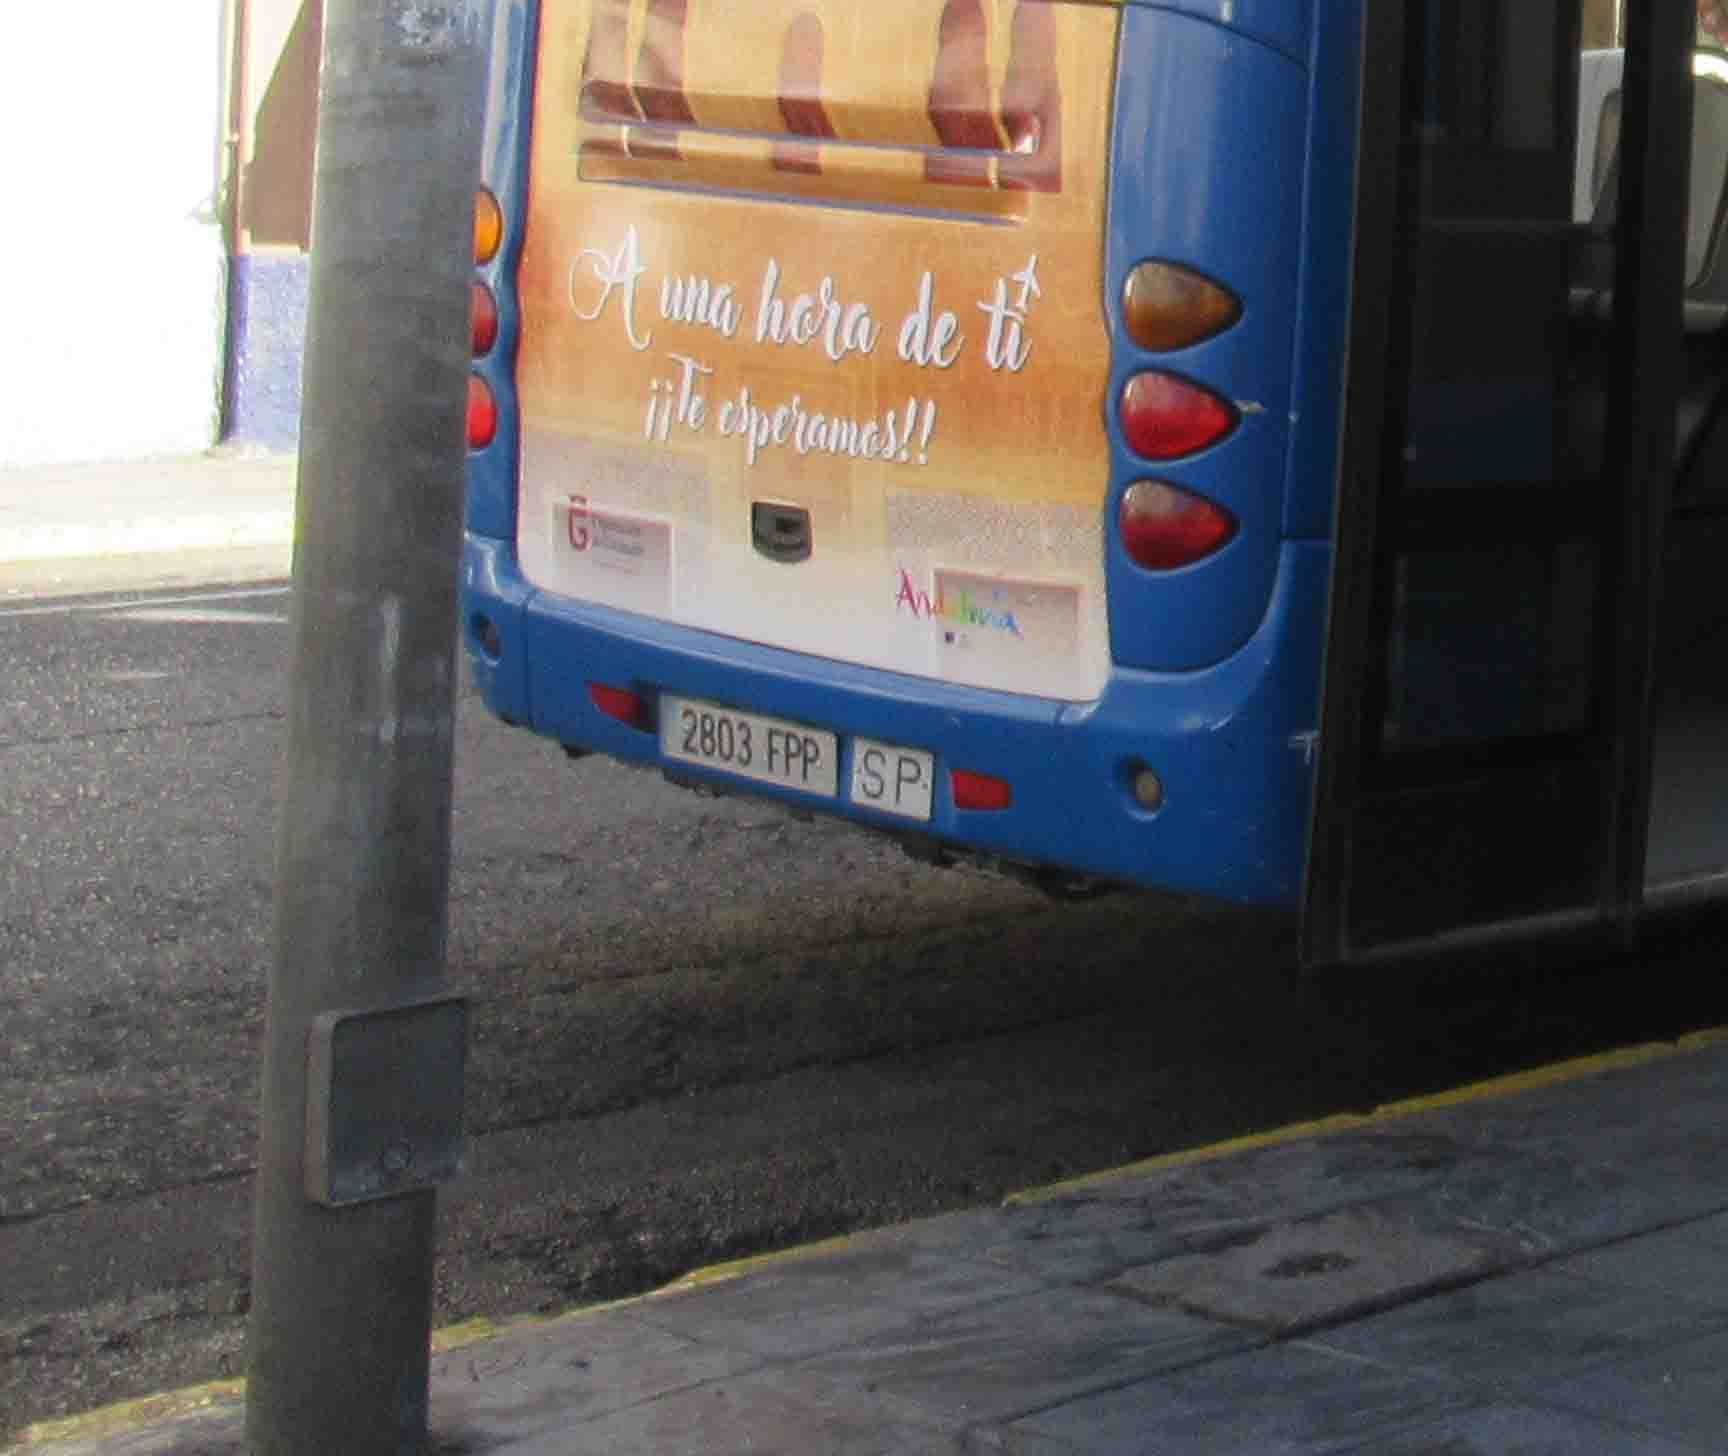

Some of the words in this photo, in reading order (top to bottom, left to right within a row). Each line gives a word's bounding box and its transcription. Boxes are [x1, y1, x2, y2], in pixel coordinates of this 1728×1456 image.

[569, 223, 652, 350] A
[660, 273, 743, 337] una
[754, 257, 881, 361] hora
[898, 271, 966, 370] de
[717, 387, 936, 465] esperamos!!
[680, 708, 753, 767] 2803
[767, 727, 820, 782] FPP
